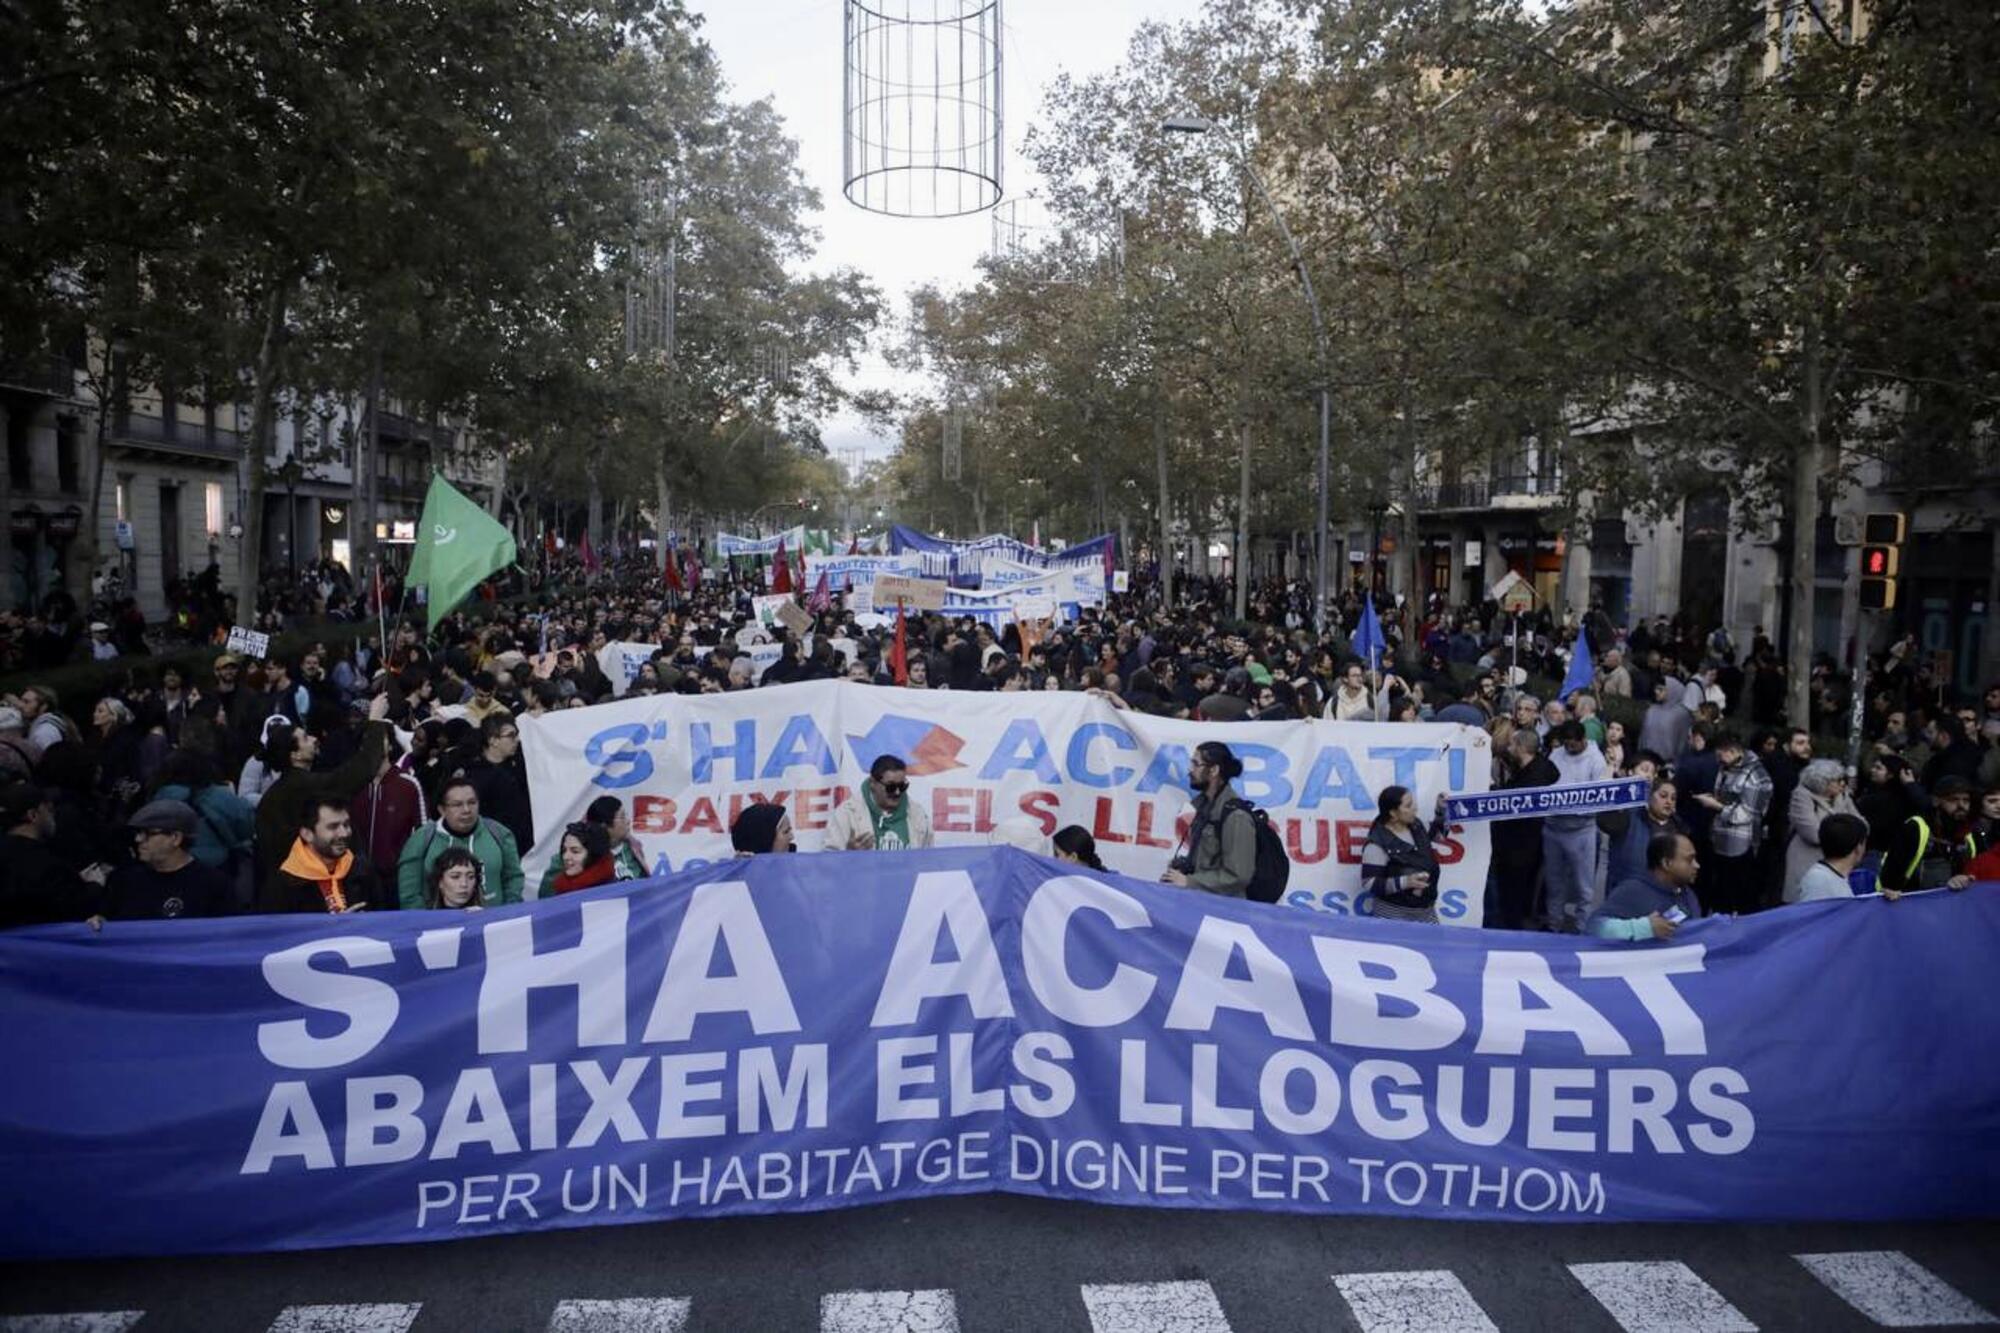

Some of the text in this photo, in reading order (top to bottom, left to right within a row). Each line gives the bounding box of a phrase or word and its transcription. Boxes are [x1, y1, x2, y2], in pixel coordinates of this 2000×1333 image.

[584, 714, 838, 789] S'HA
[976, 718, 1468, 812] ACABAT!
[632, 785, 1466, 866] BAIE ELS LLUES
[1477, 786, 1619, 814] FORÇA SINDICAT
[256, 870, 1708, 1070] S'HA ACABAT
[239, 1030, 1756, 1174] ABAIXEM ELS LLOGUERS
[416, 1131, 1607, 1228] PER UN HABITATGE DIGNE PER TOTHOM
